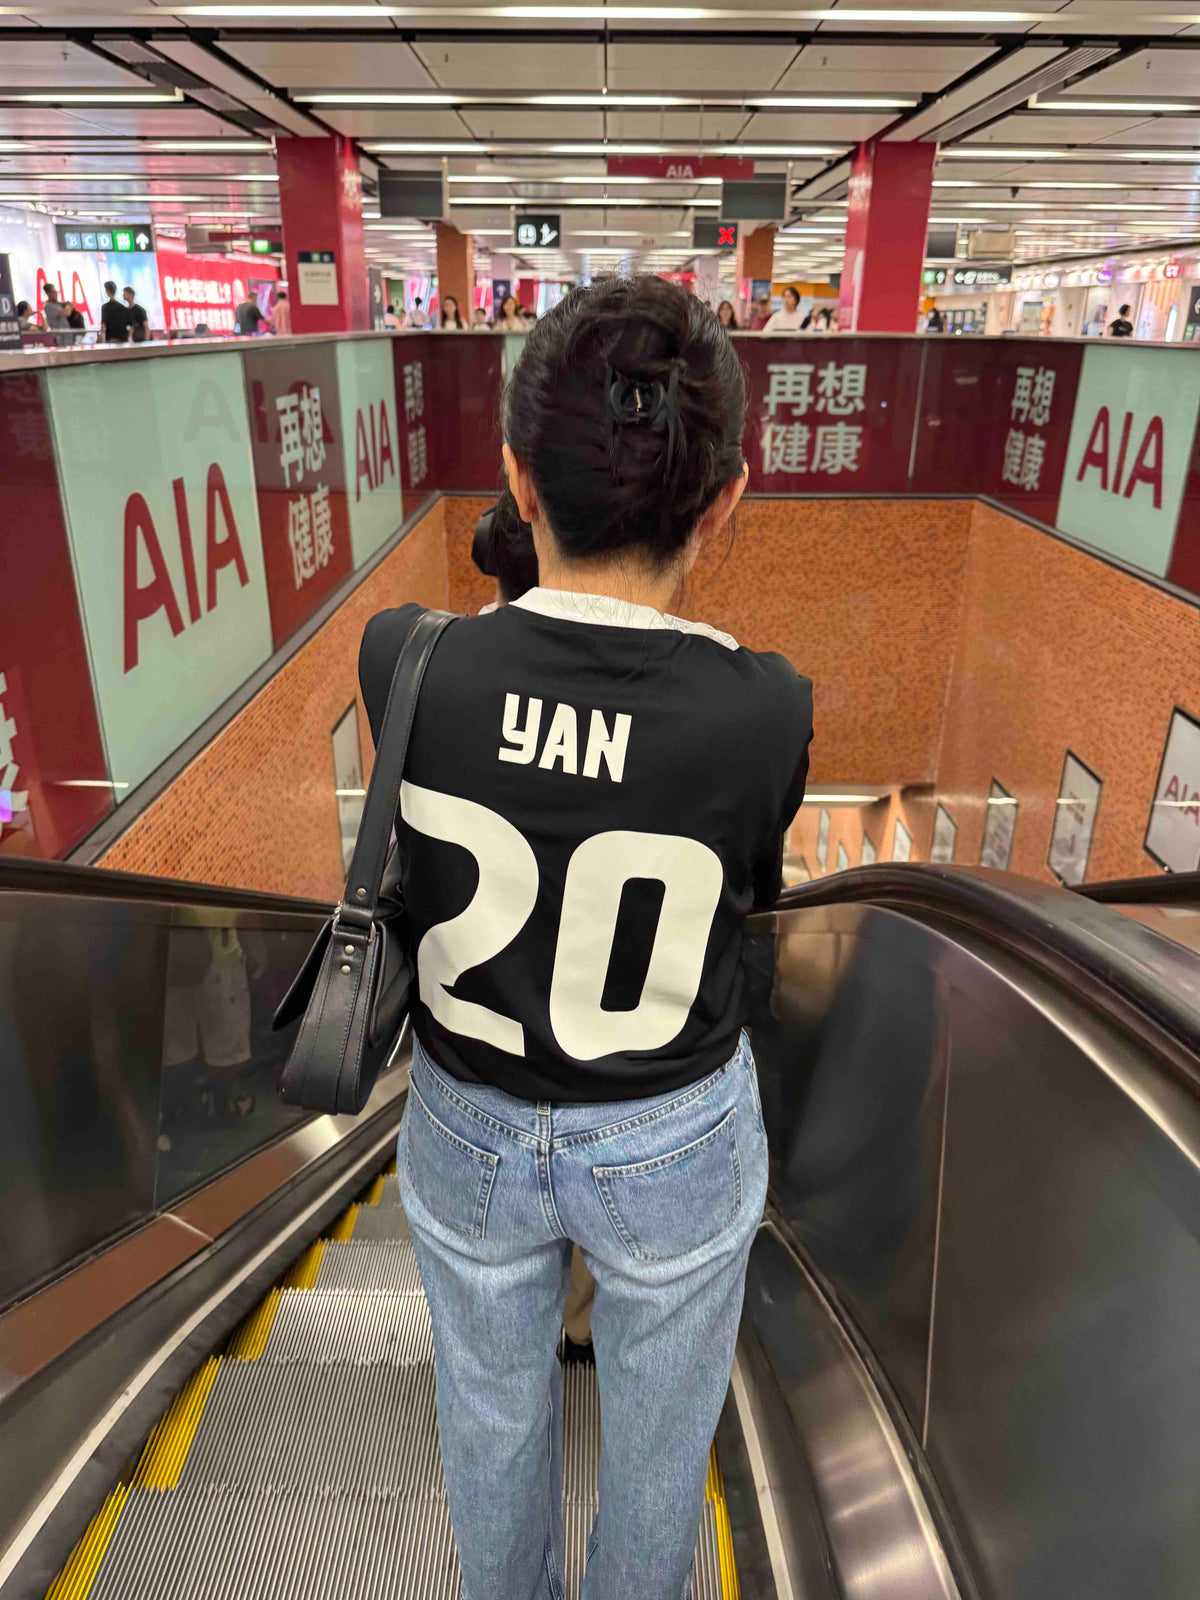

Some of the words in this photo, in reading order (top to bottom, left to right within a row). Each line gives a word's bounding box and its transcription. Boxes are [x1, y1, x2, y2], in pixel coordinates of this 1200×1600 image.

[665, 164, 695, 179] AIA
[275, 385, 327, 490] 再想
[763, 362, 868, 417] 再想
[1009, 366, 1057, 427] 再想
[355, 398, 396, 503] AIA
[759, 421, 863, 475] 健康
[1001, 428, 1047, 492] 健康
[1076, 405, 1164, 510] AIA
[123, 462, 250, 675] AIA
[288, 482, 335, 591] 健康
[498, 692, 632, 783] YAN
[400, 779, 724, 1061] 20
